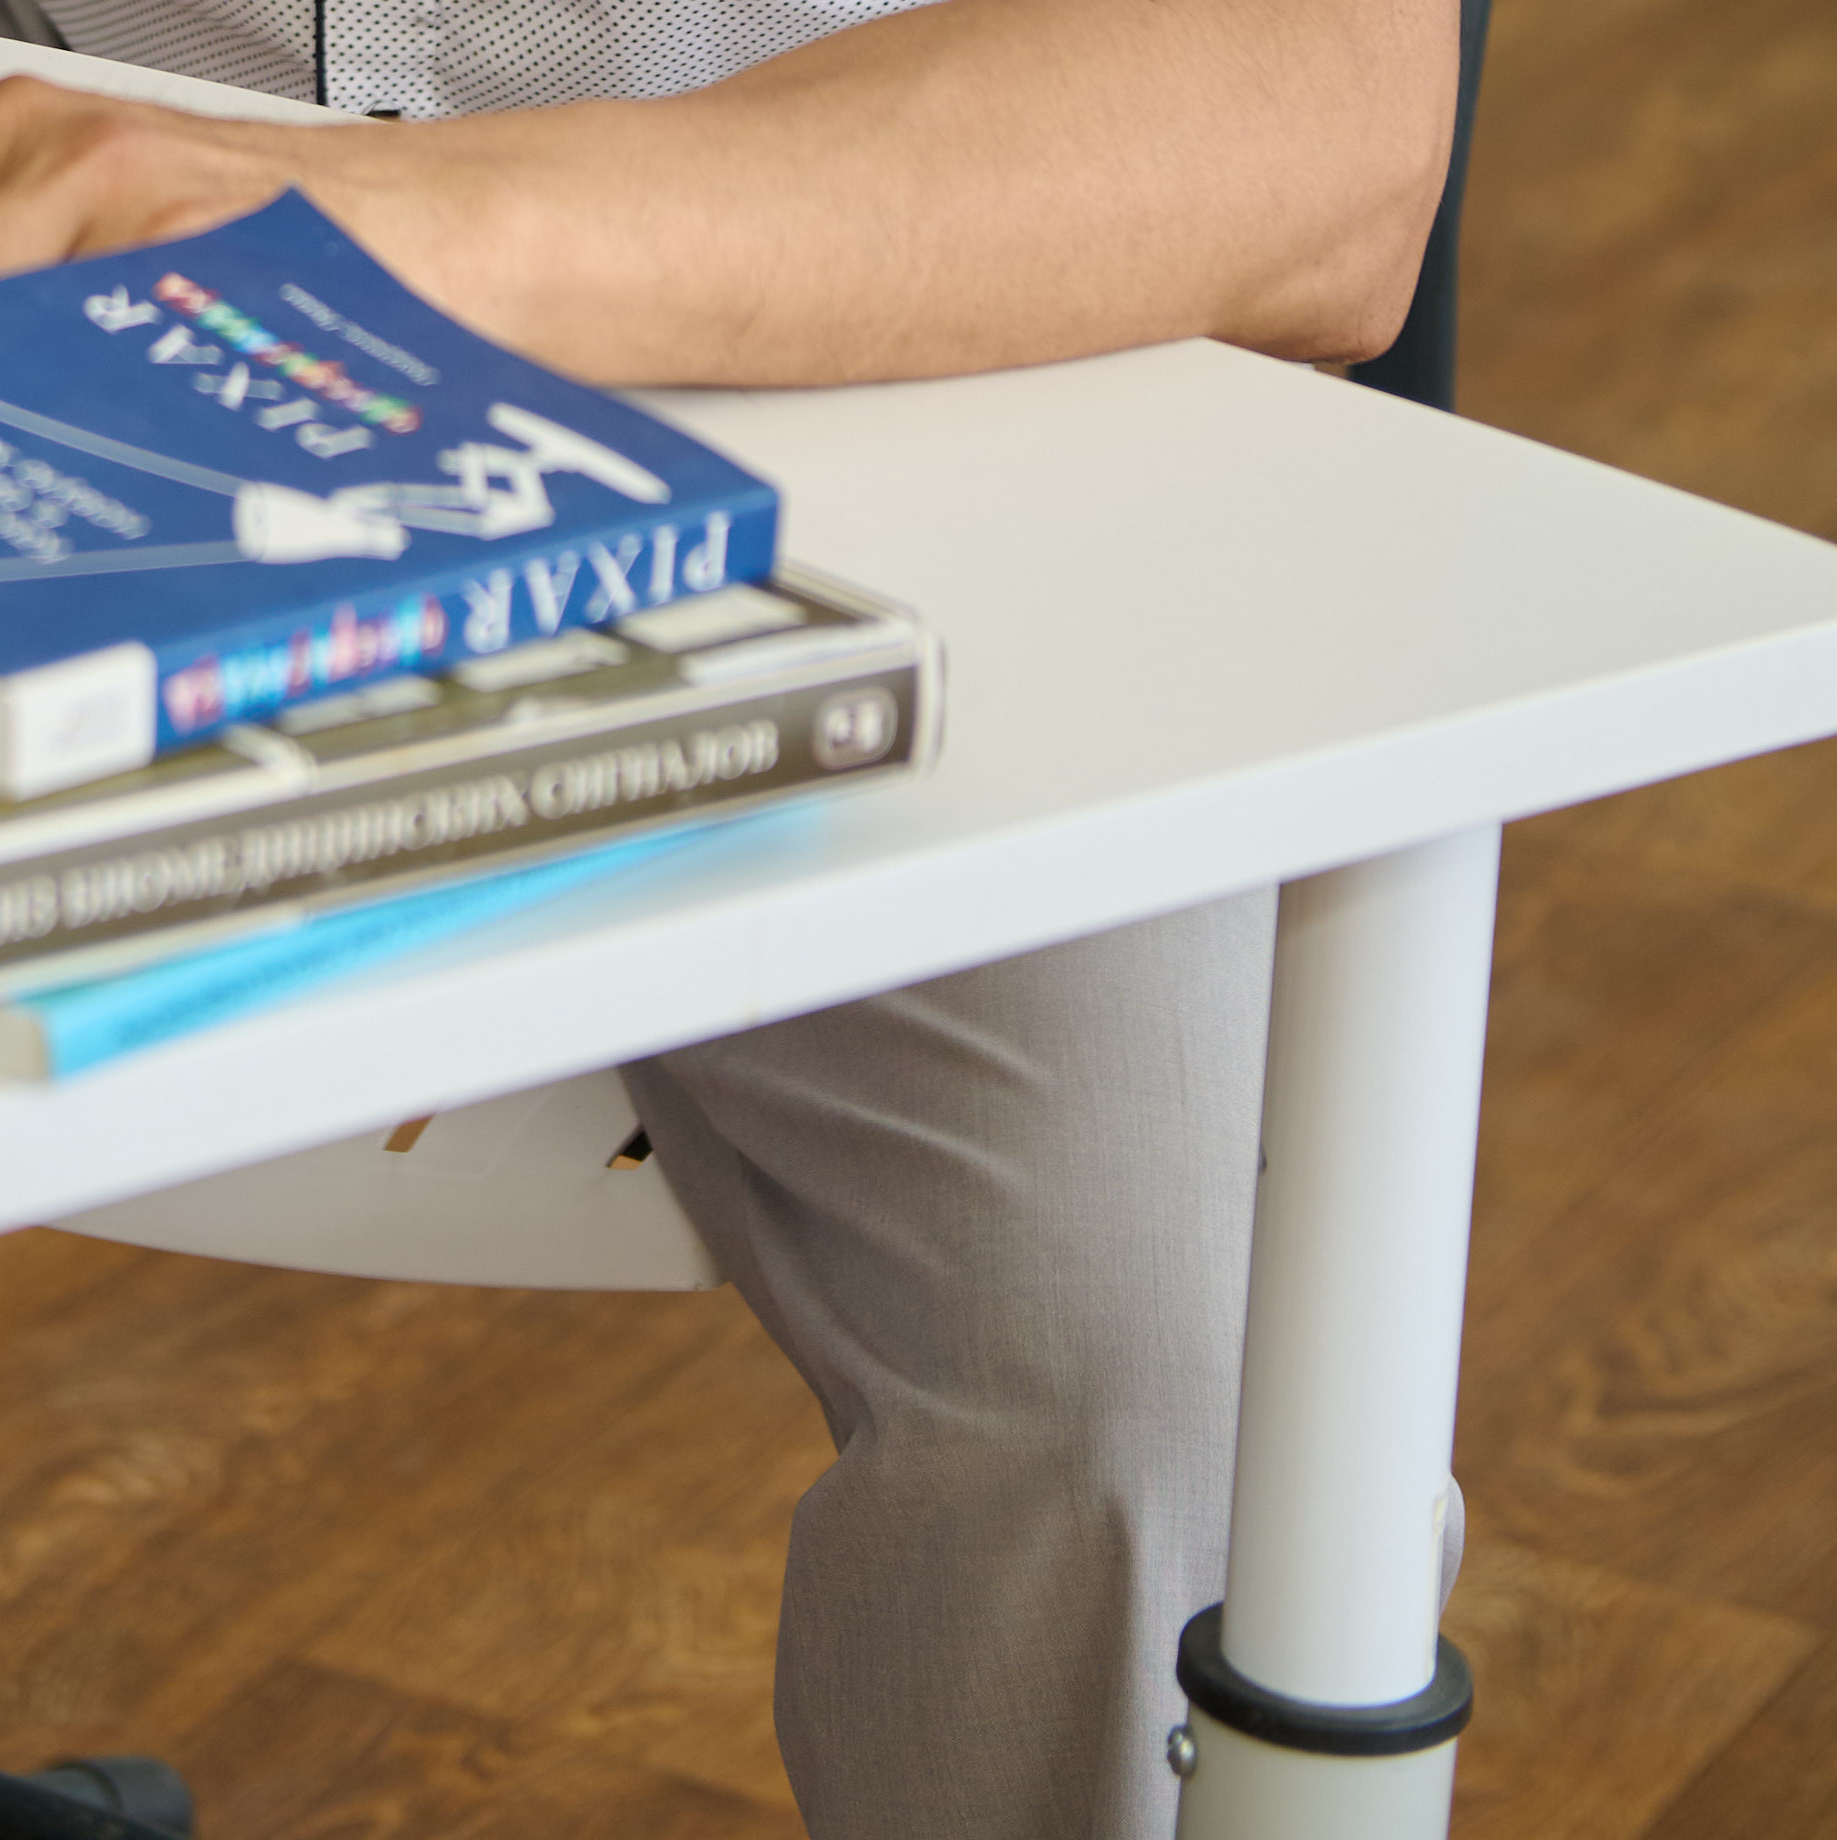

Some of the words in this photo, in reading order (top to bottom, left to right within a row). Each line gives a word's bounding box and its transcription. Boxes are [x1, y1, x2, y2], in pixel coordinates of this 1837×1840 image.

[81, 283, 374, 459] PIXAR
[462, 509, 733, 655] PIXAR
[531, 720, 781, 820] СИГНАЛОВ
